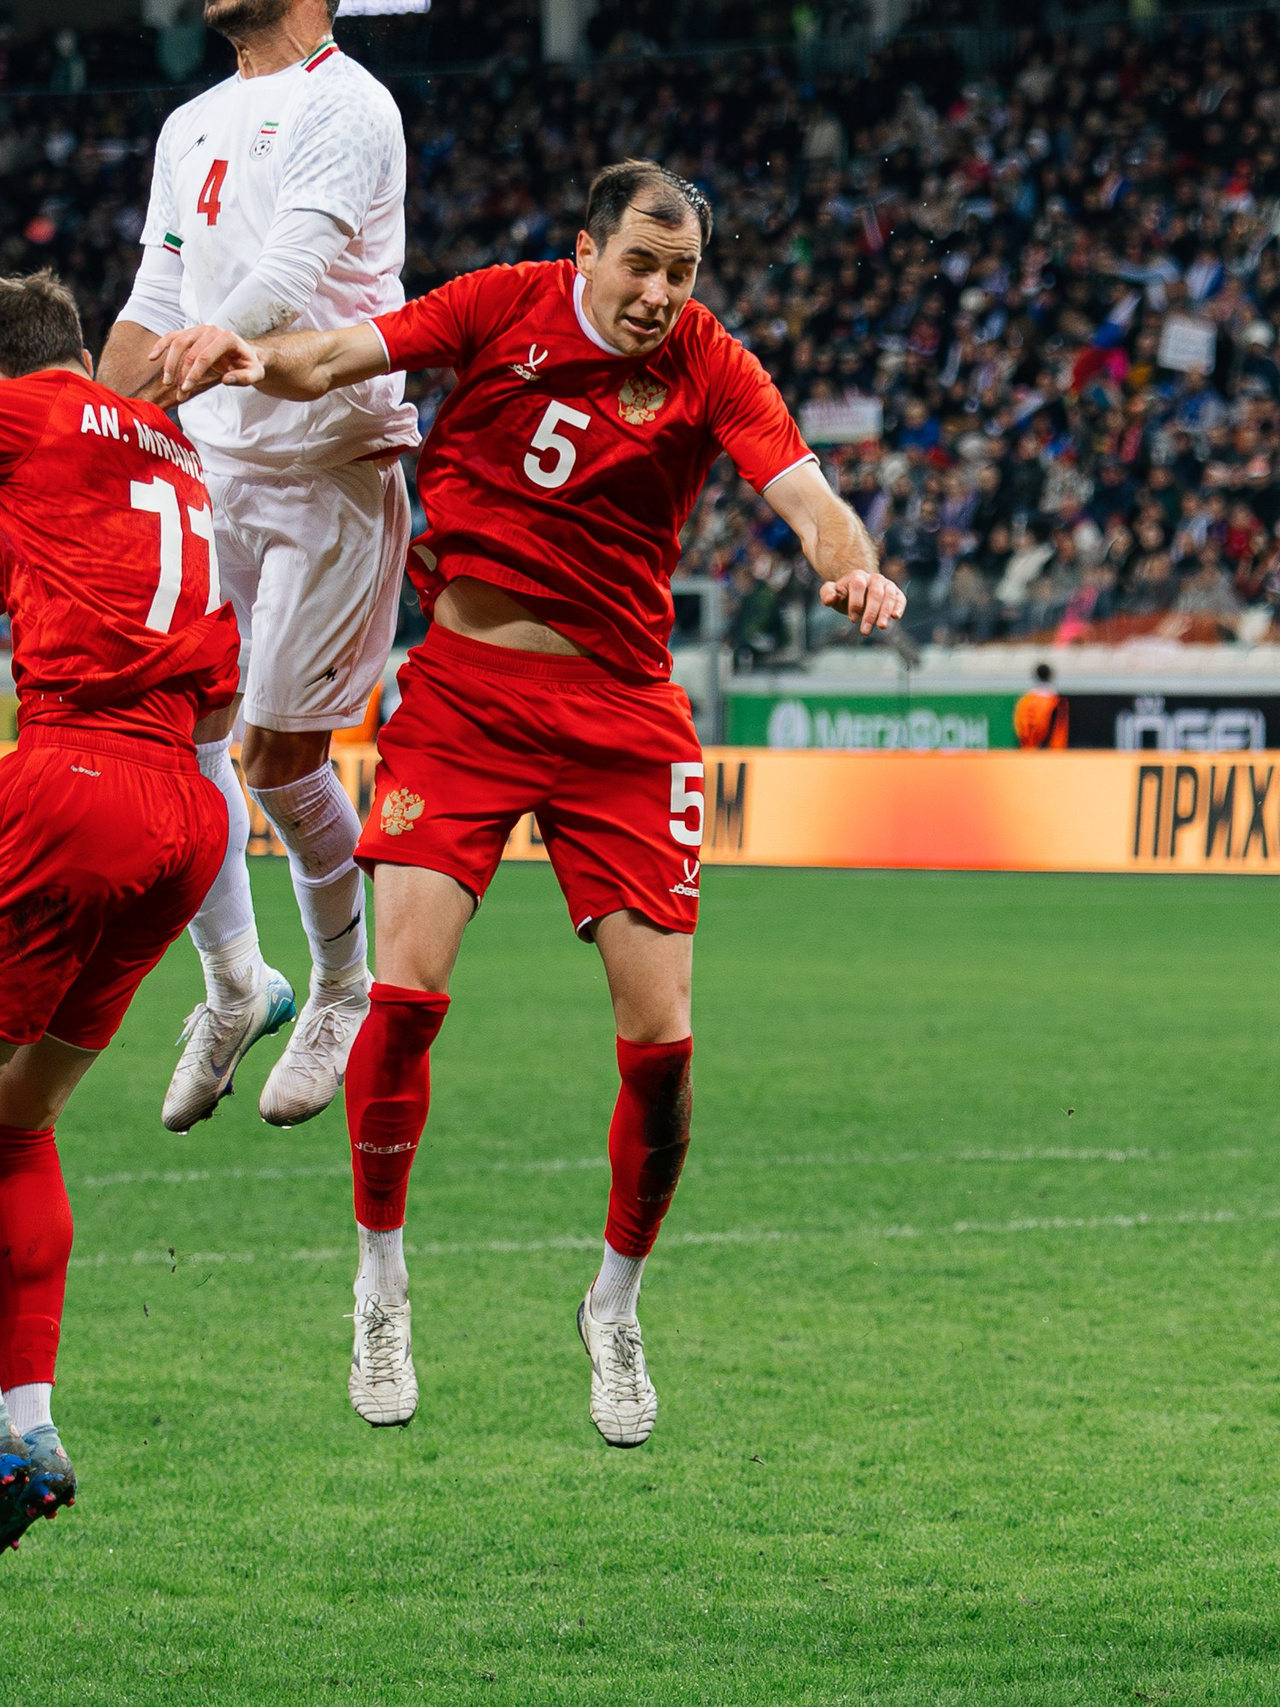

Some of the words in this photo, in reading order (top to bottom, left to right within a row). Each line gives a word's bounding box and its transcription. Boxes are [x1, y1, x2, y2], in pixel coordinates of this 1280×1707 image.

[197, 159, 229, 226] 4
[81, 403, 130, 442] AN.
[523, 400, 592, 489] 5
[669, 762, 705, 846] 5
[669, 883, 701, 898] JÖGE
